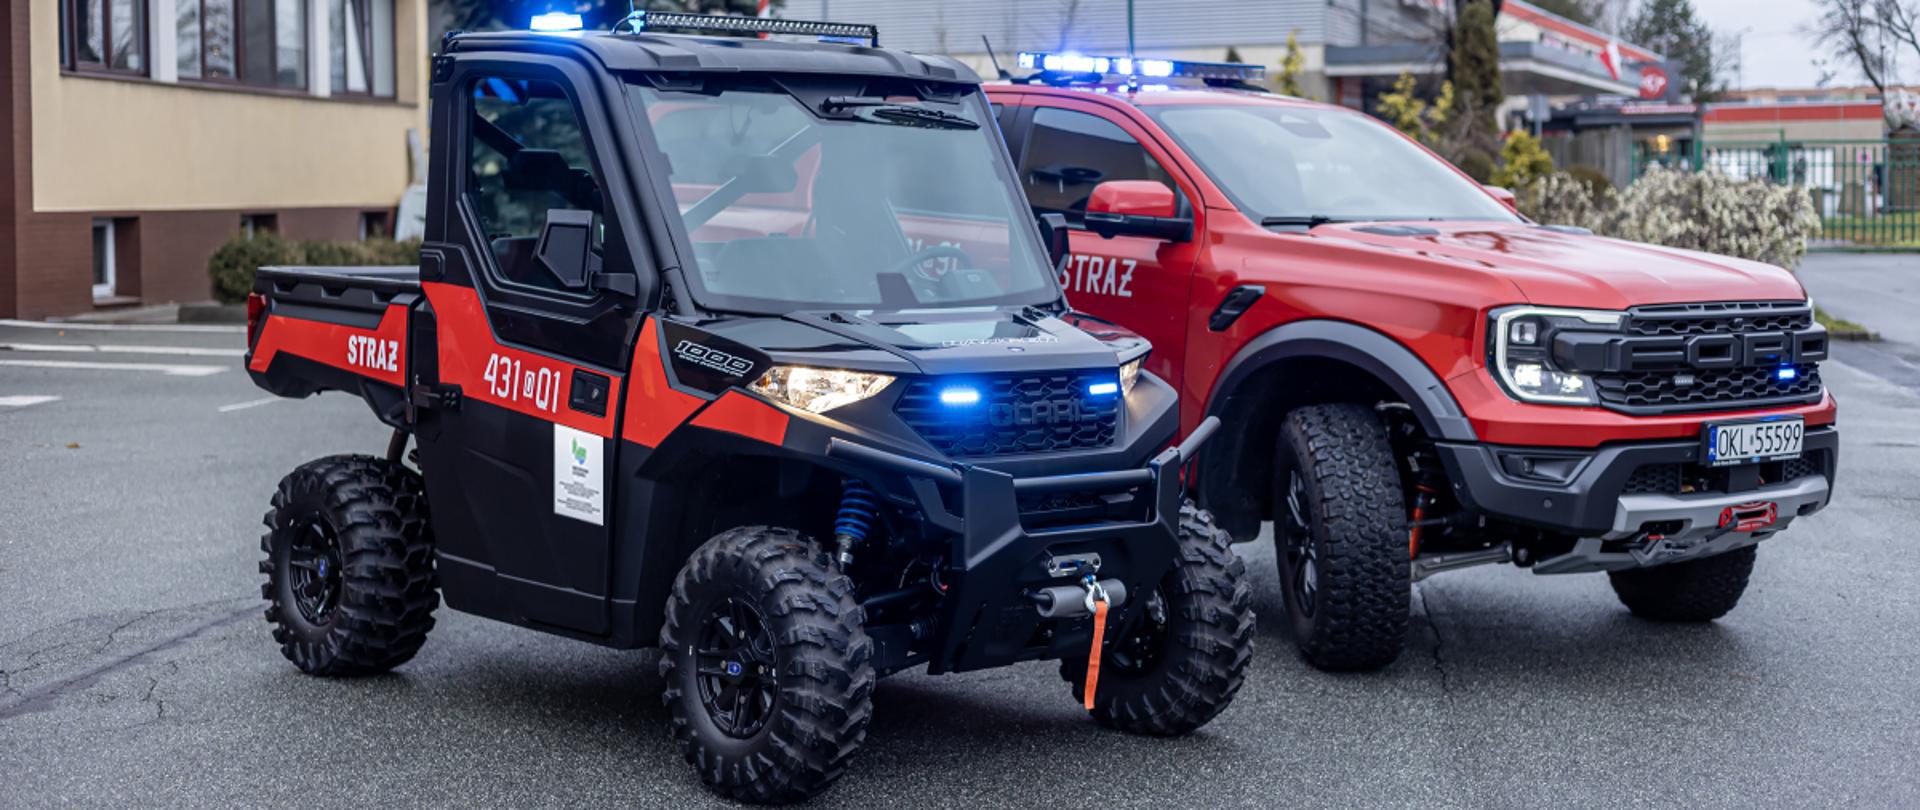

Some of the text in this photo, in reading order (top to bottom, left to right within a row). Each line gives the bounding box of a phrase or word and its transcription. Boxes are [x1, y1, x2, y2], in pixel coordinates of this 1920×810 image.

[674, 340, 754, 374] 1000
[966, 398, 1098, 427] OLARIS
[1718, 423, 1801, 457] OKL 55599
